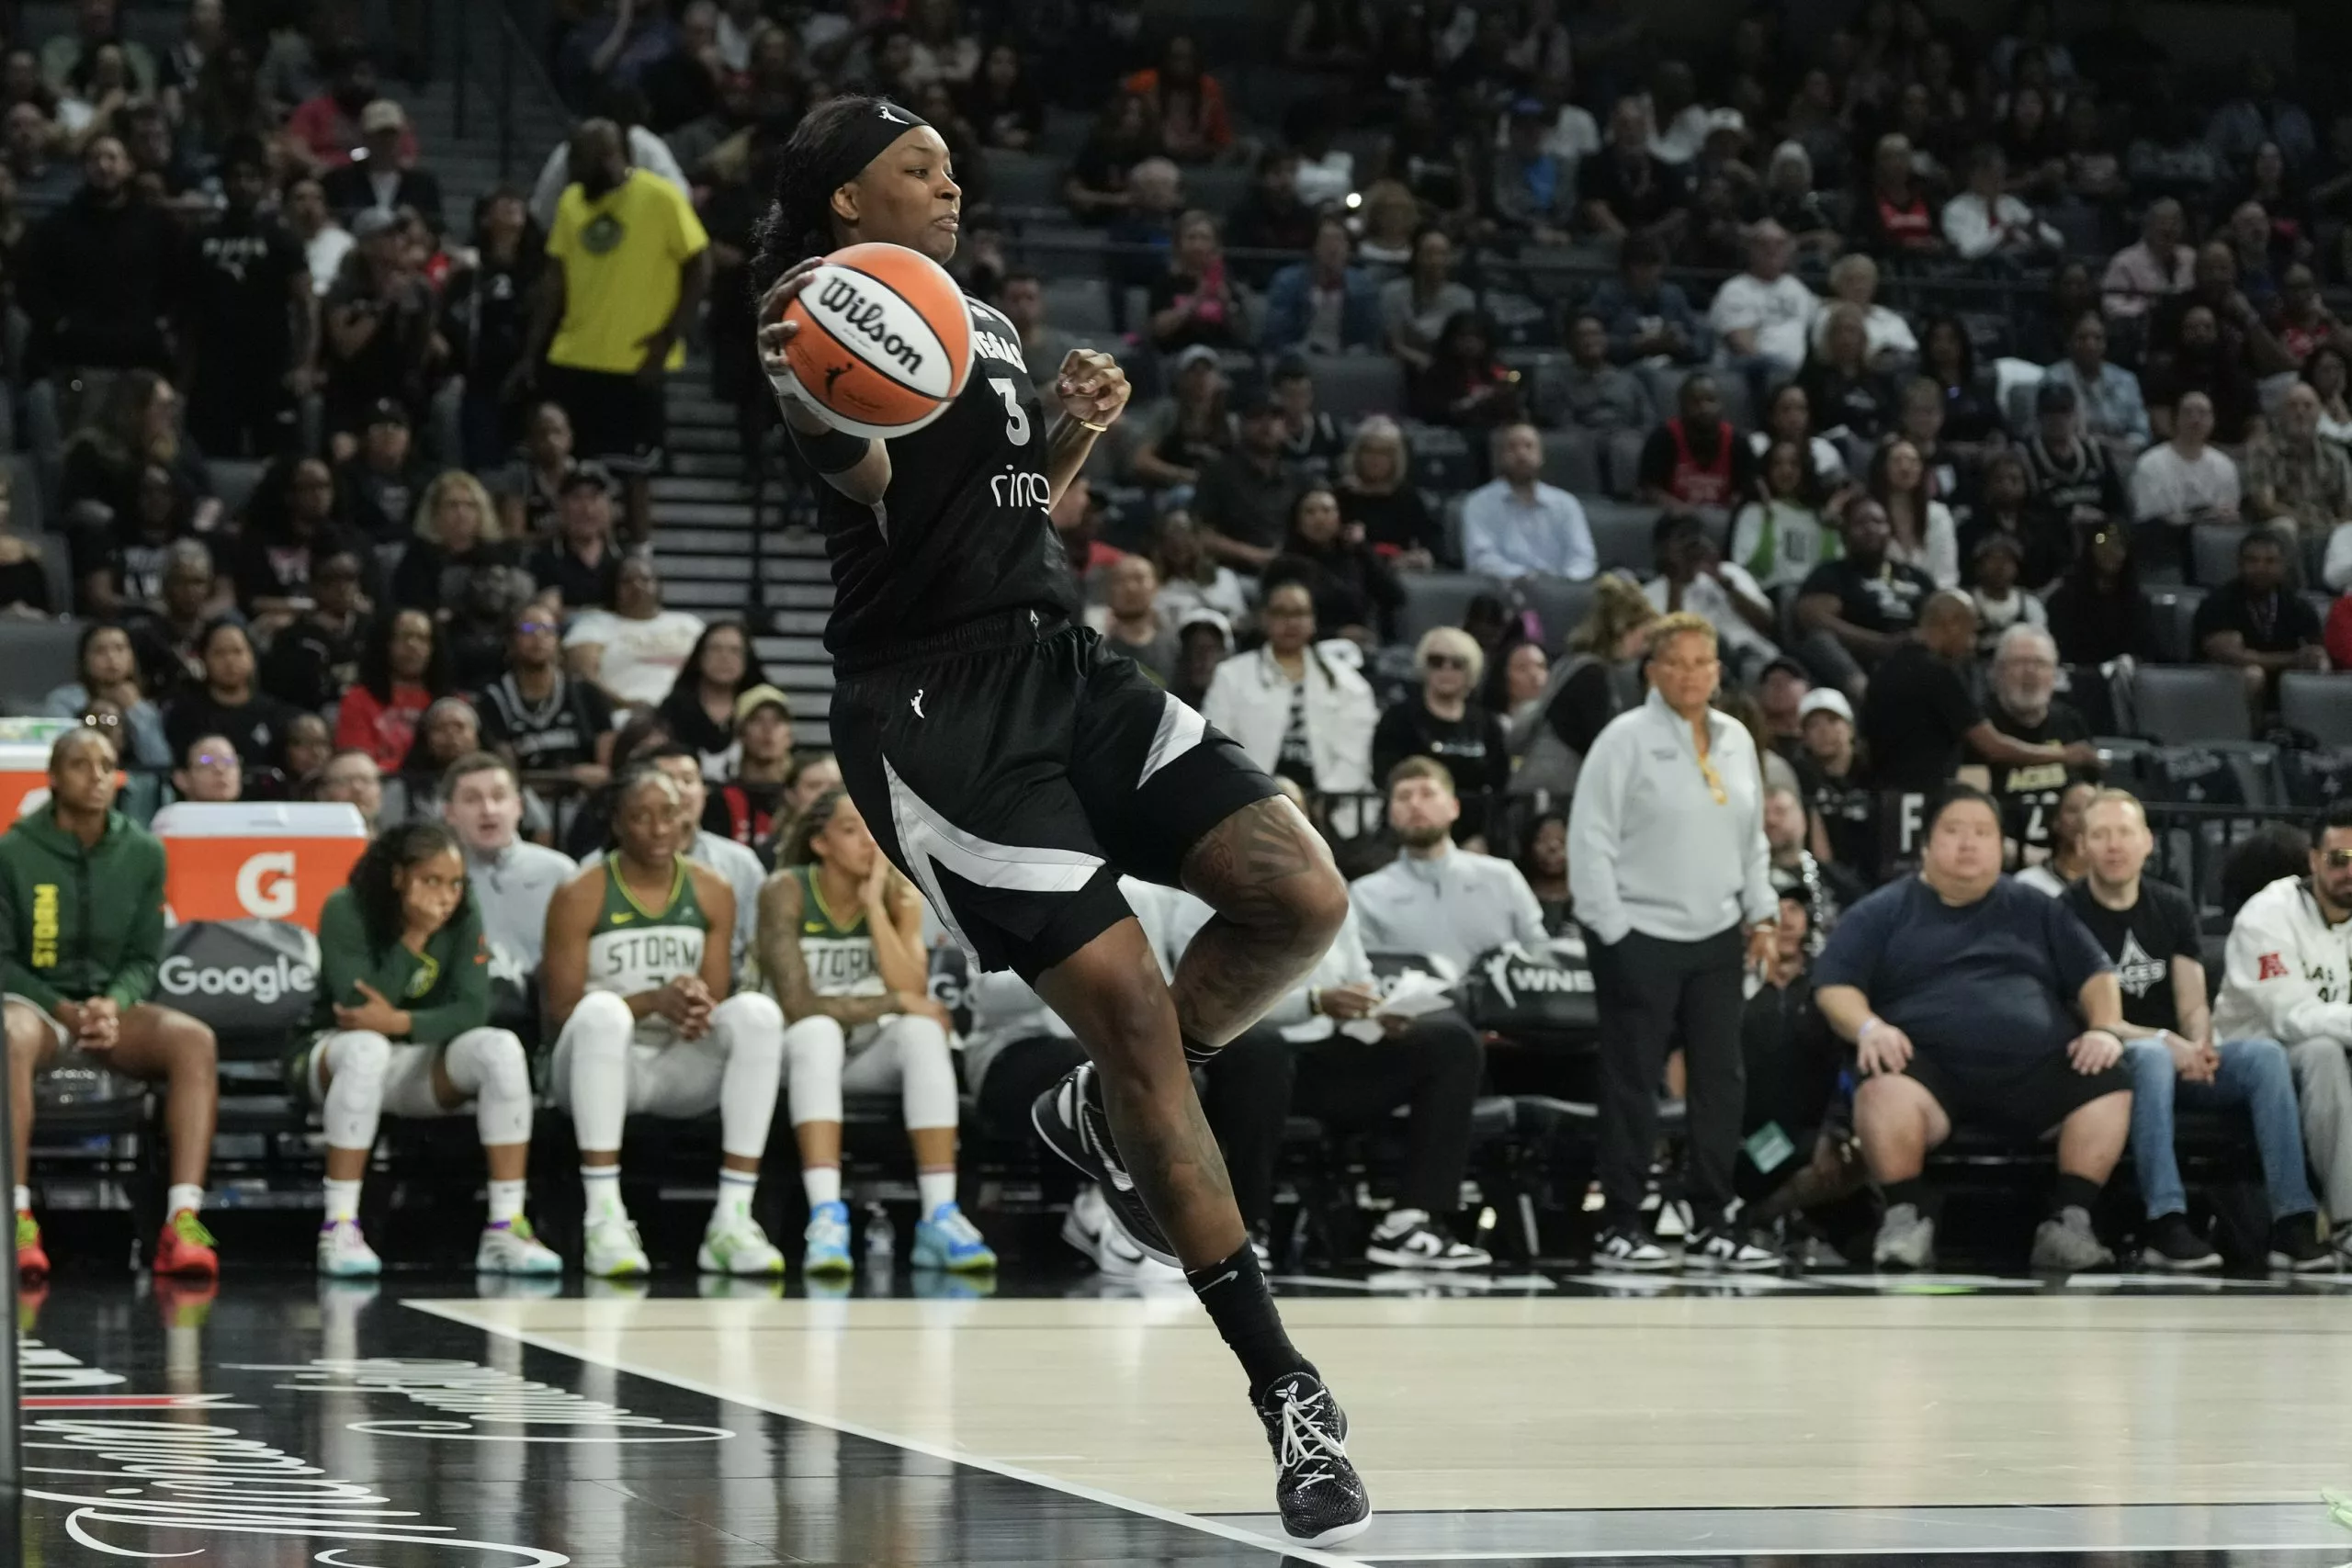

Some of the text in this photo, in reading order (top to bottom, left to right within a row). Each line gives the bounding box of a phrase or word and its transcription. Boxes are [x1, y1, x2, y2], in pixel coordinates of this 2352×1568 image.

[819, 275, 924, 377] Wilson
[987, 378, 1031, 446] 3
[990, 464, 1050, 514] ring
[235, 852, 296, 919] G
[31, 884, 59, 967] STORM
[158, 955, 316, 1004] Google
[806, 946, 880, 979] TOR
[1512, 967, 1597, 993] WNB
[20, 1418, 573, 1568] Michelob
